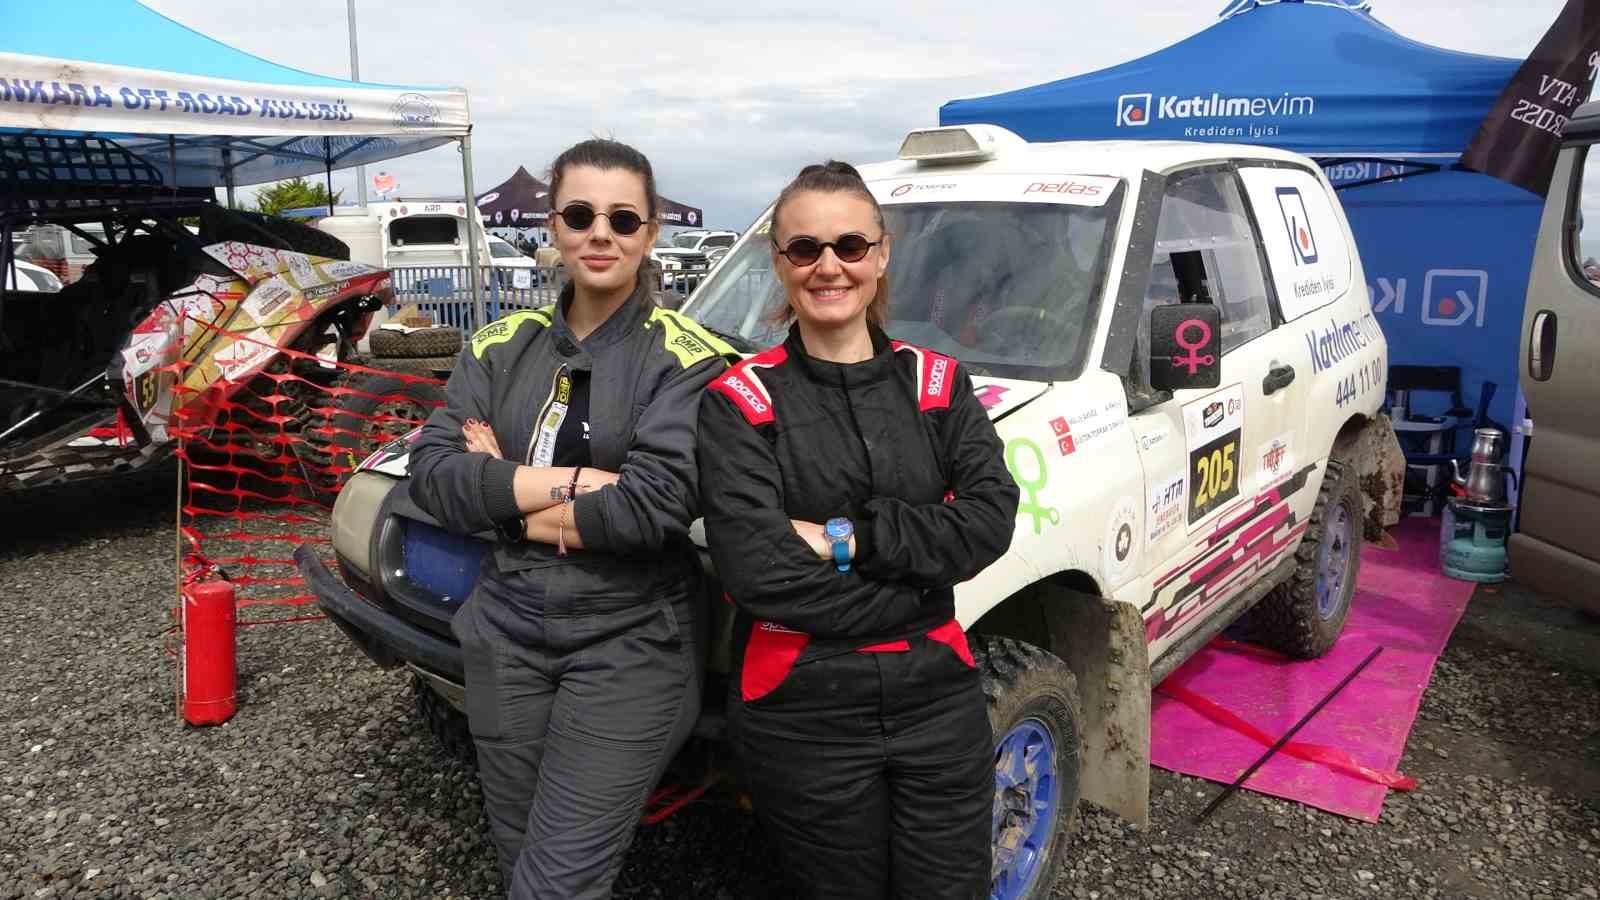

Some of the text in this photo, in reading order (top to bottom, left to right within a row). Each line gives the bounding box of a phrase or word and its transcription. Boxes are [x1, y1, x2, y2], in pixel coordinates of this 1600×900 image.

[119, 86, 254, 117] OFF-ROAD
[1157, 92, 1315, 120] Katılımevim
[1184, 126, 1244, 138] Krediden
[1022, 179, 1104, 200] petlas
[674, 334, 703, 354] OMP
[558, 375, 570, 403] OMP
[926, 358, 949, 397] sparco
[1335, 356, 1383, 409] 444 11 00
[724, 376, 768, 415] sparco
[1194, 440, 1235, 509] 205
